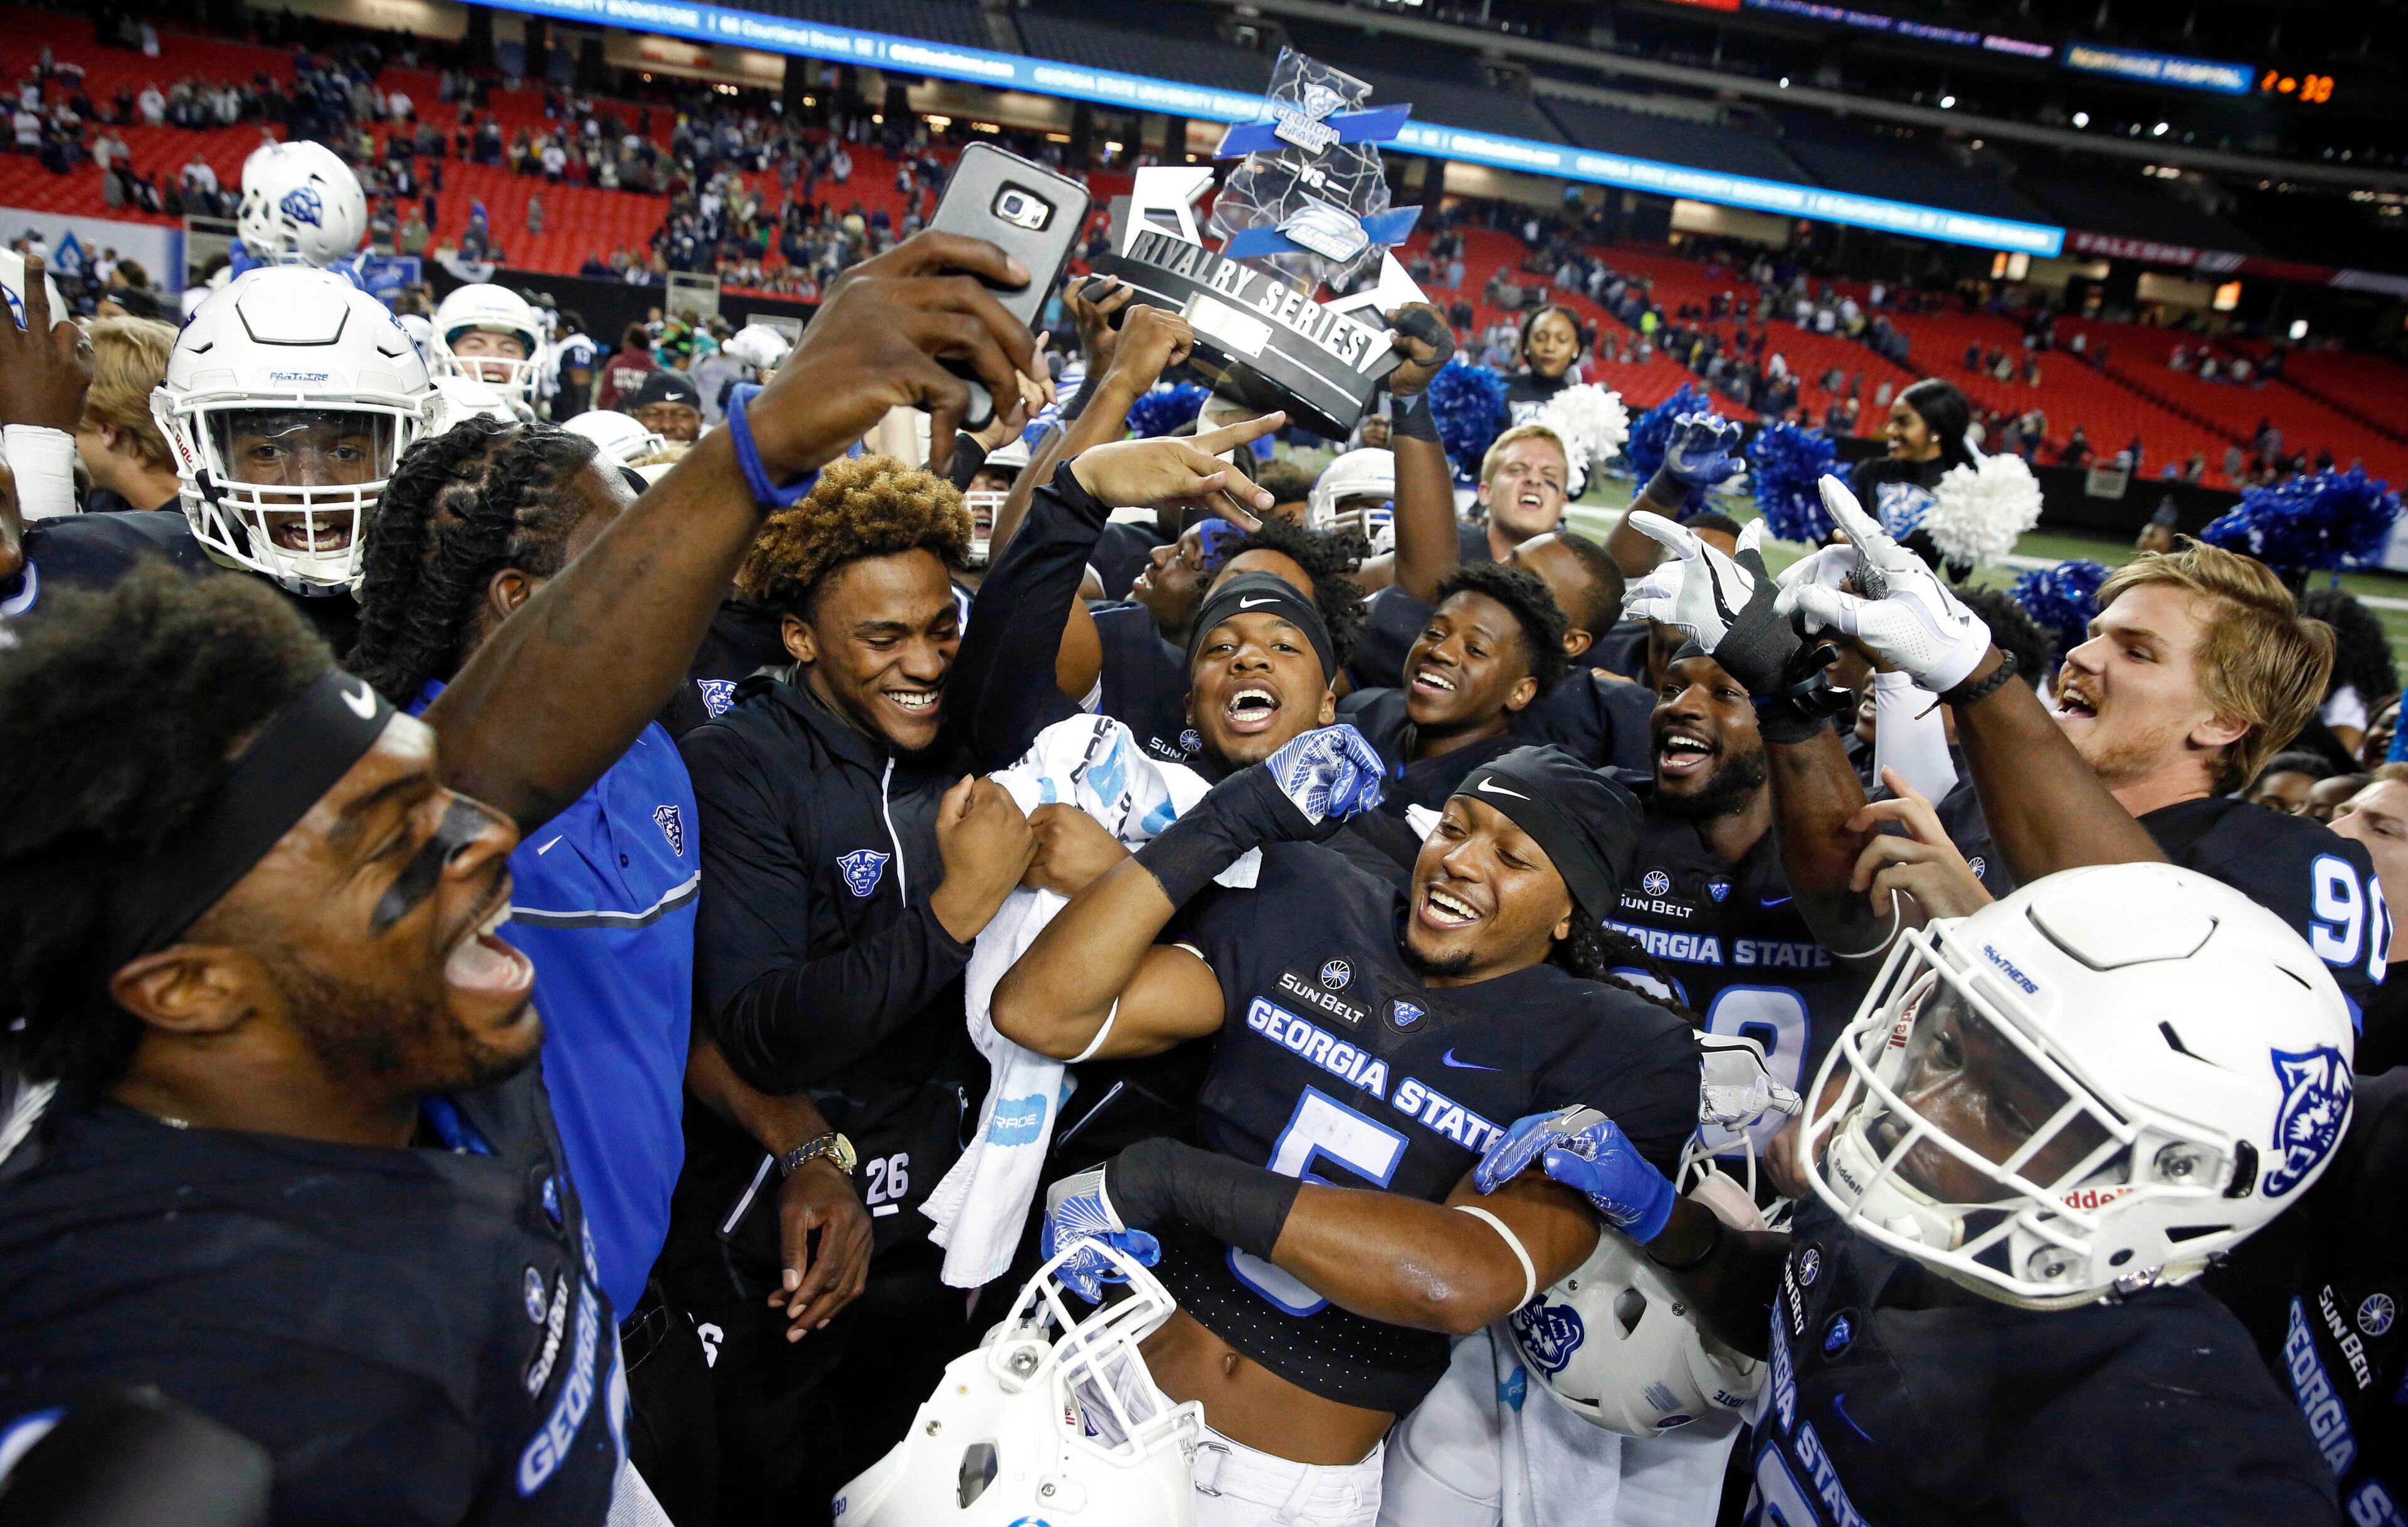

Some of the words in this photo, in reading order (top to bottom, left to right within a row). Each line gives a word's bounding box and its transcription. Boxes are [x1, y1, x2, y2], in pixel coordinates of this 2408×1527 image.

[1300, 164, 1326, 188] VS
[1131, 230, 1258, 302] RIVALRY
[1259, 281, 1365, 364] SERIES
[1149, 736, 1181, 759] SUN
[1652, 899, 1693, 918] BELT
[1279, 971, 1320, 1006] SUN
[1320, 993, 1365, 1024] BELT
[1247, 996, 1389, 1101] GEORGIA
[867, 1153, 909, 1205] 26
[1834, 1158, 1864, 1196] Riddell
[1789, 1286, 1806, 1336] BELT
[2318, 1284, 2347, 1340] SUN
[2340, 1333, 2372, 1391] BELT
